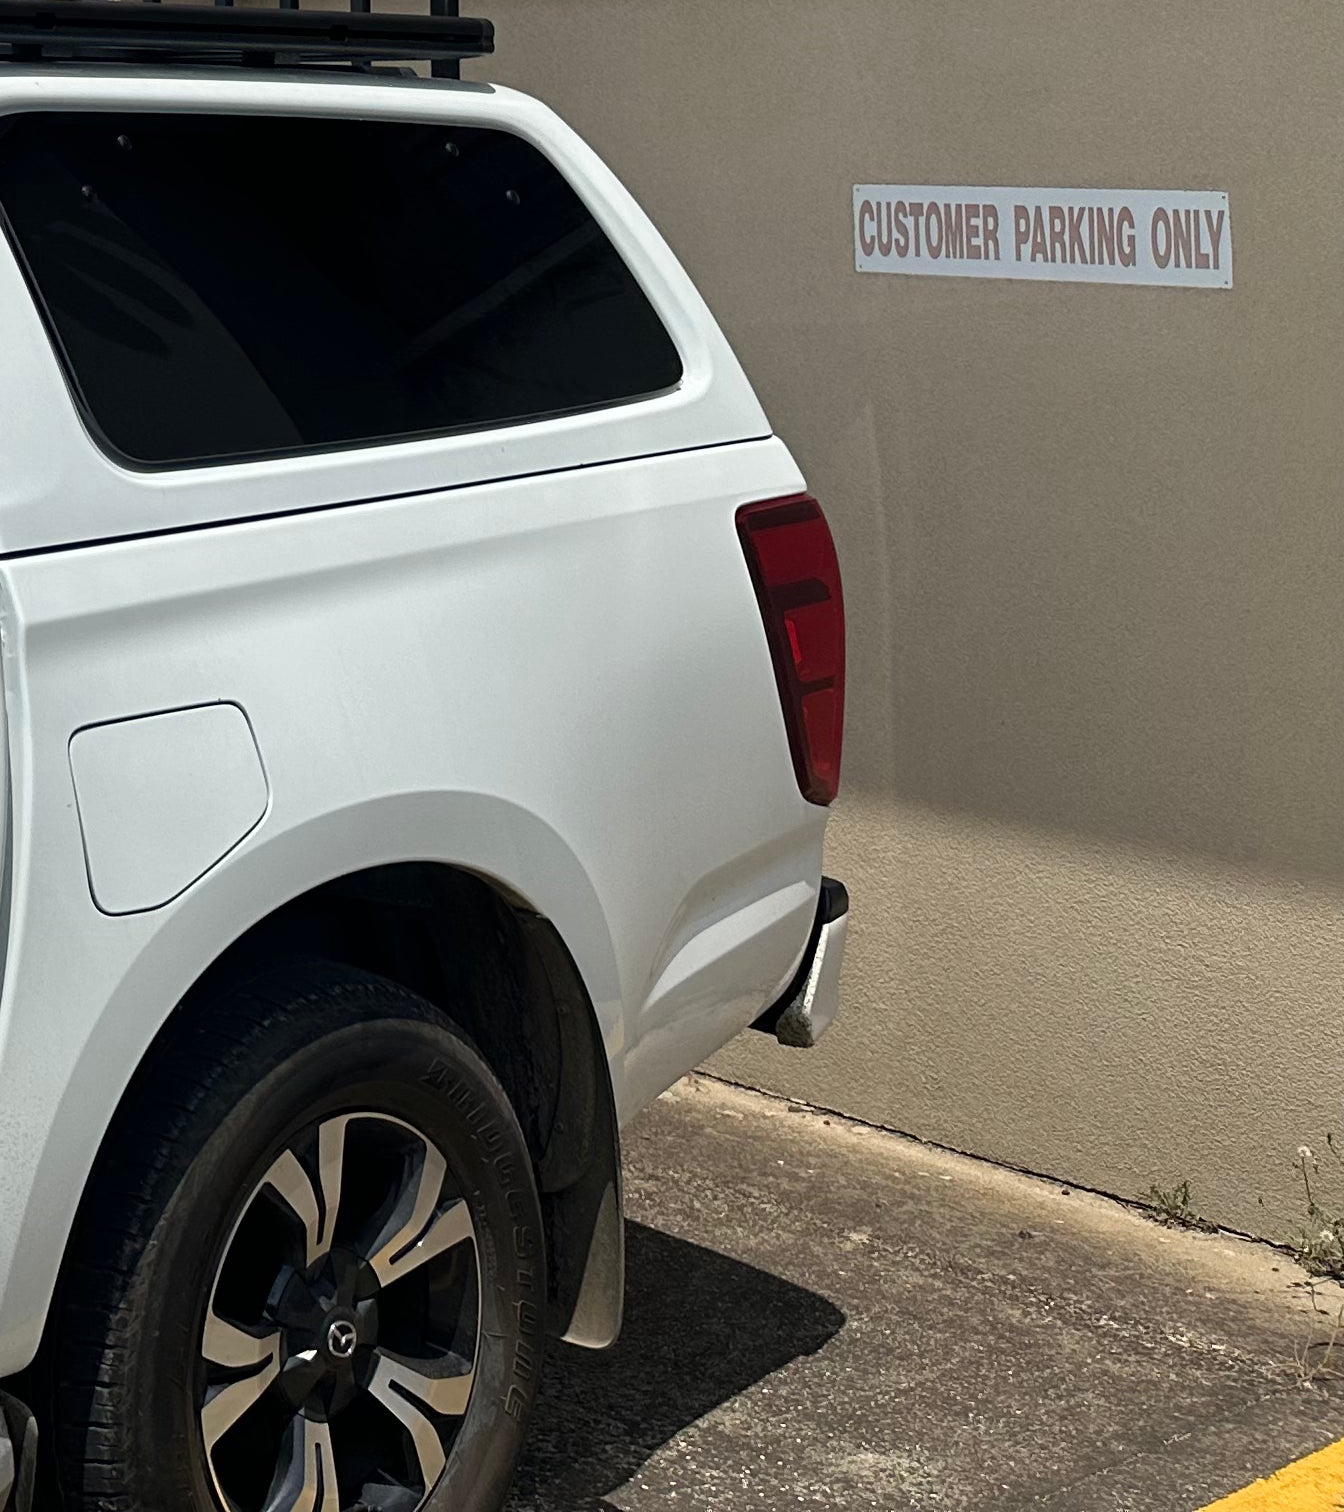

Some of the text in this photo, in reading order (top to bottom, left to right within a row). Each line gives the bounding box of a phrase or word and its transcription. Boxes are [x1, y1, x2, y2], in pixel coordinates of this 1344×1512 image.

[859, 199, 1225, 270] CUSTOMER PARKING ONLY
